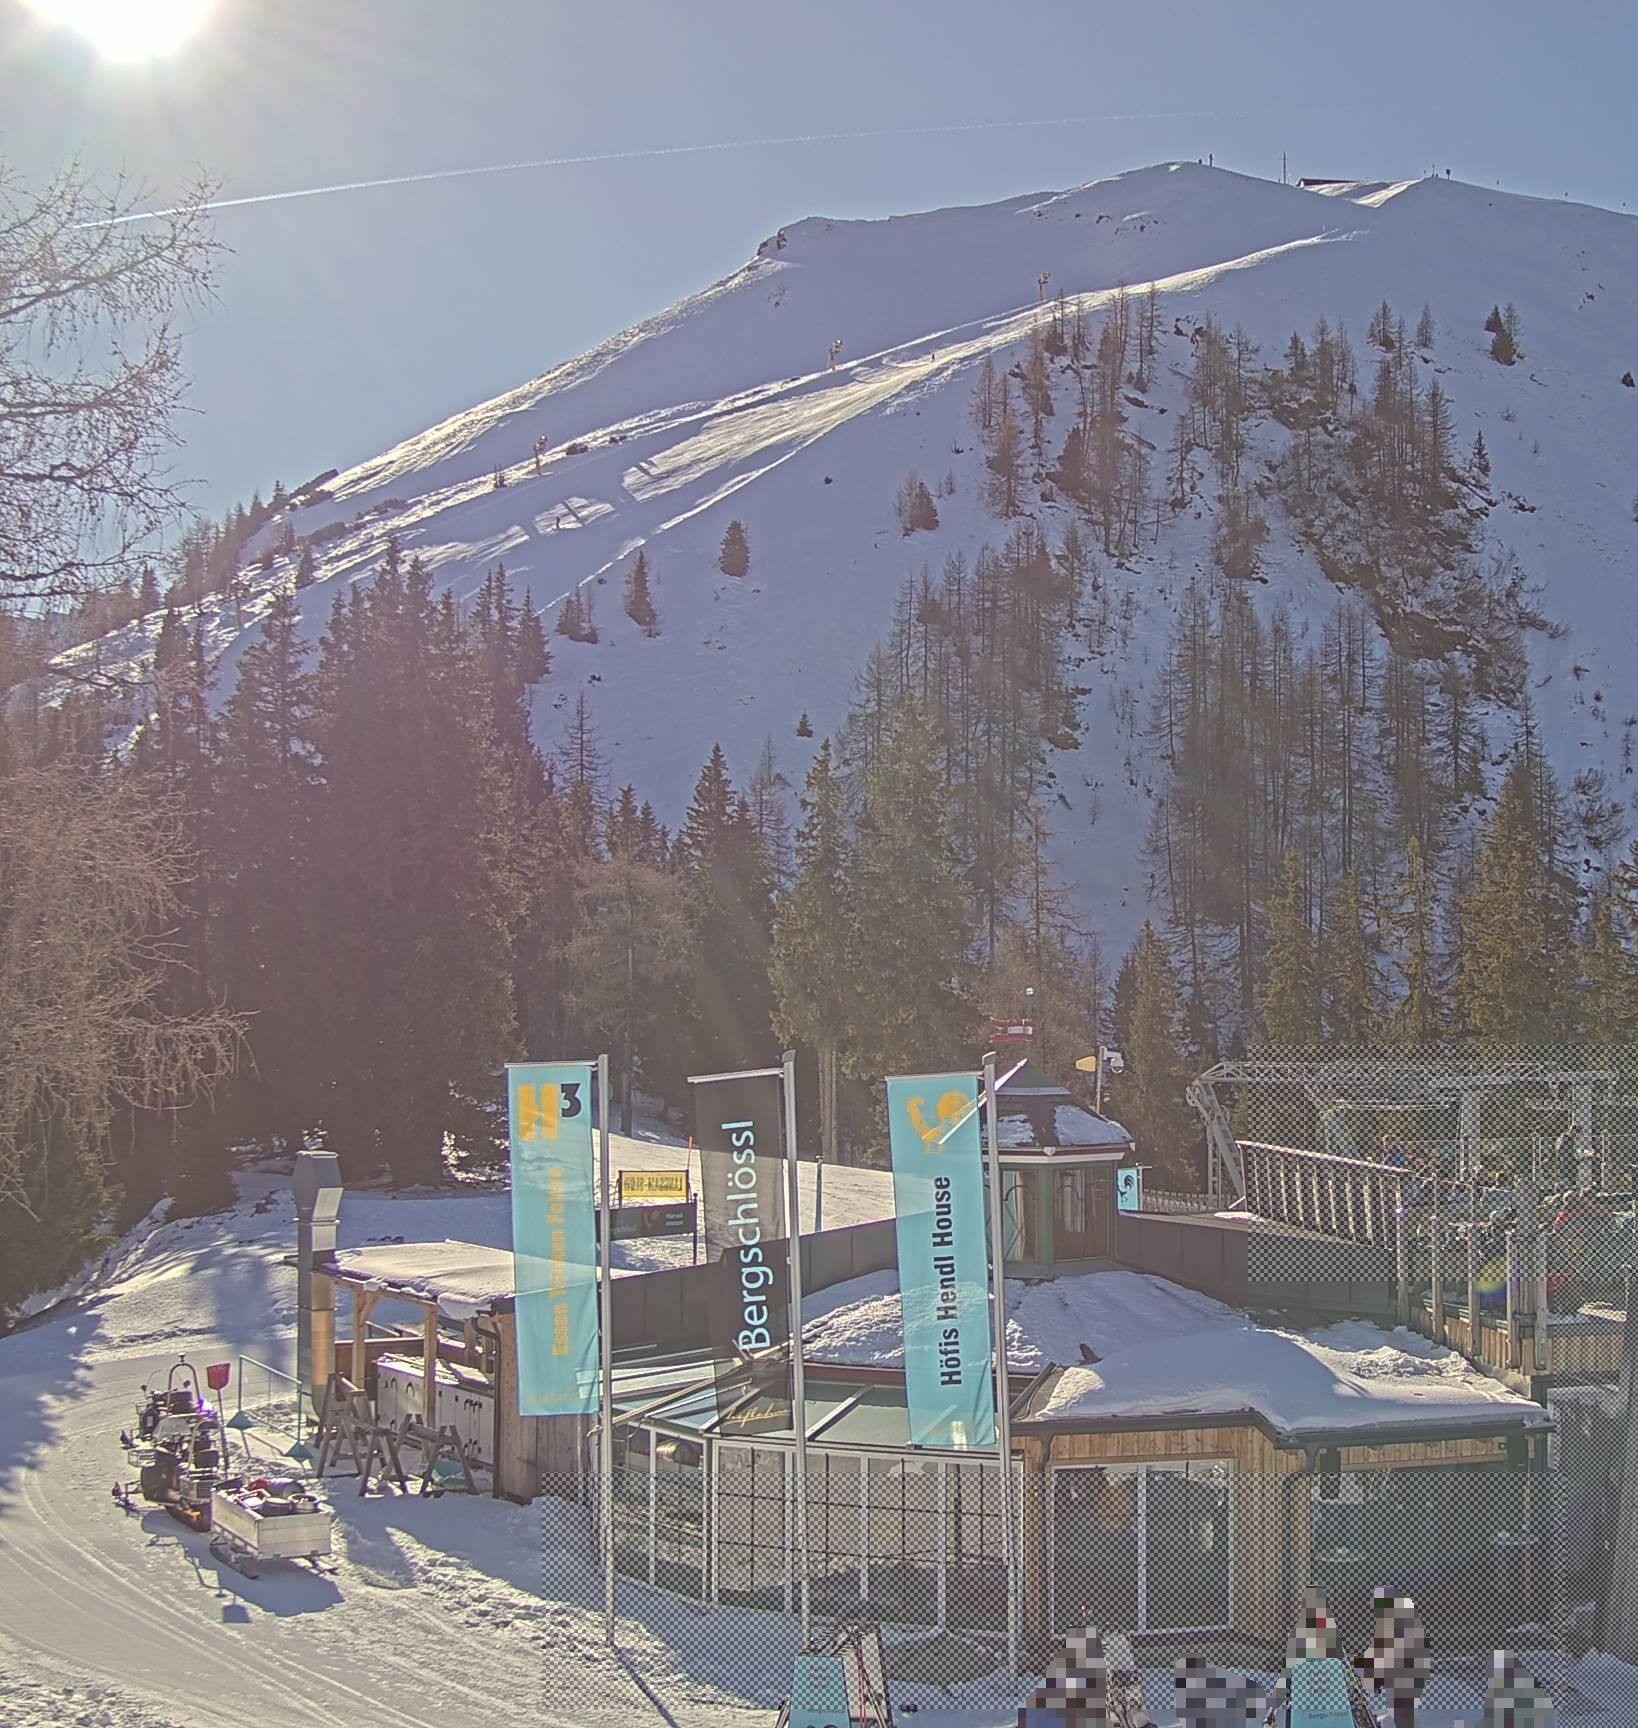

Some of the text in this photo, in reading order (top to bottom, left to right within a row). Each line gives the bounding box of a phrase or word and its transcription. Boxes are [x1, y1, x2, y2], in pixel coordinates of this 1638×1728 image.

[721, 1121, 774, 1351] Bergschlössl
[932, 1176, 962, 1386] Höfis Hendl House
